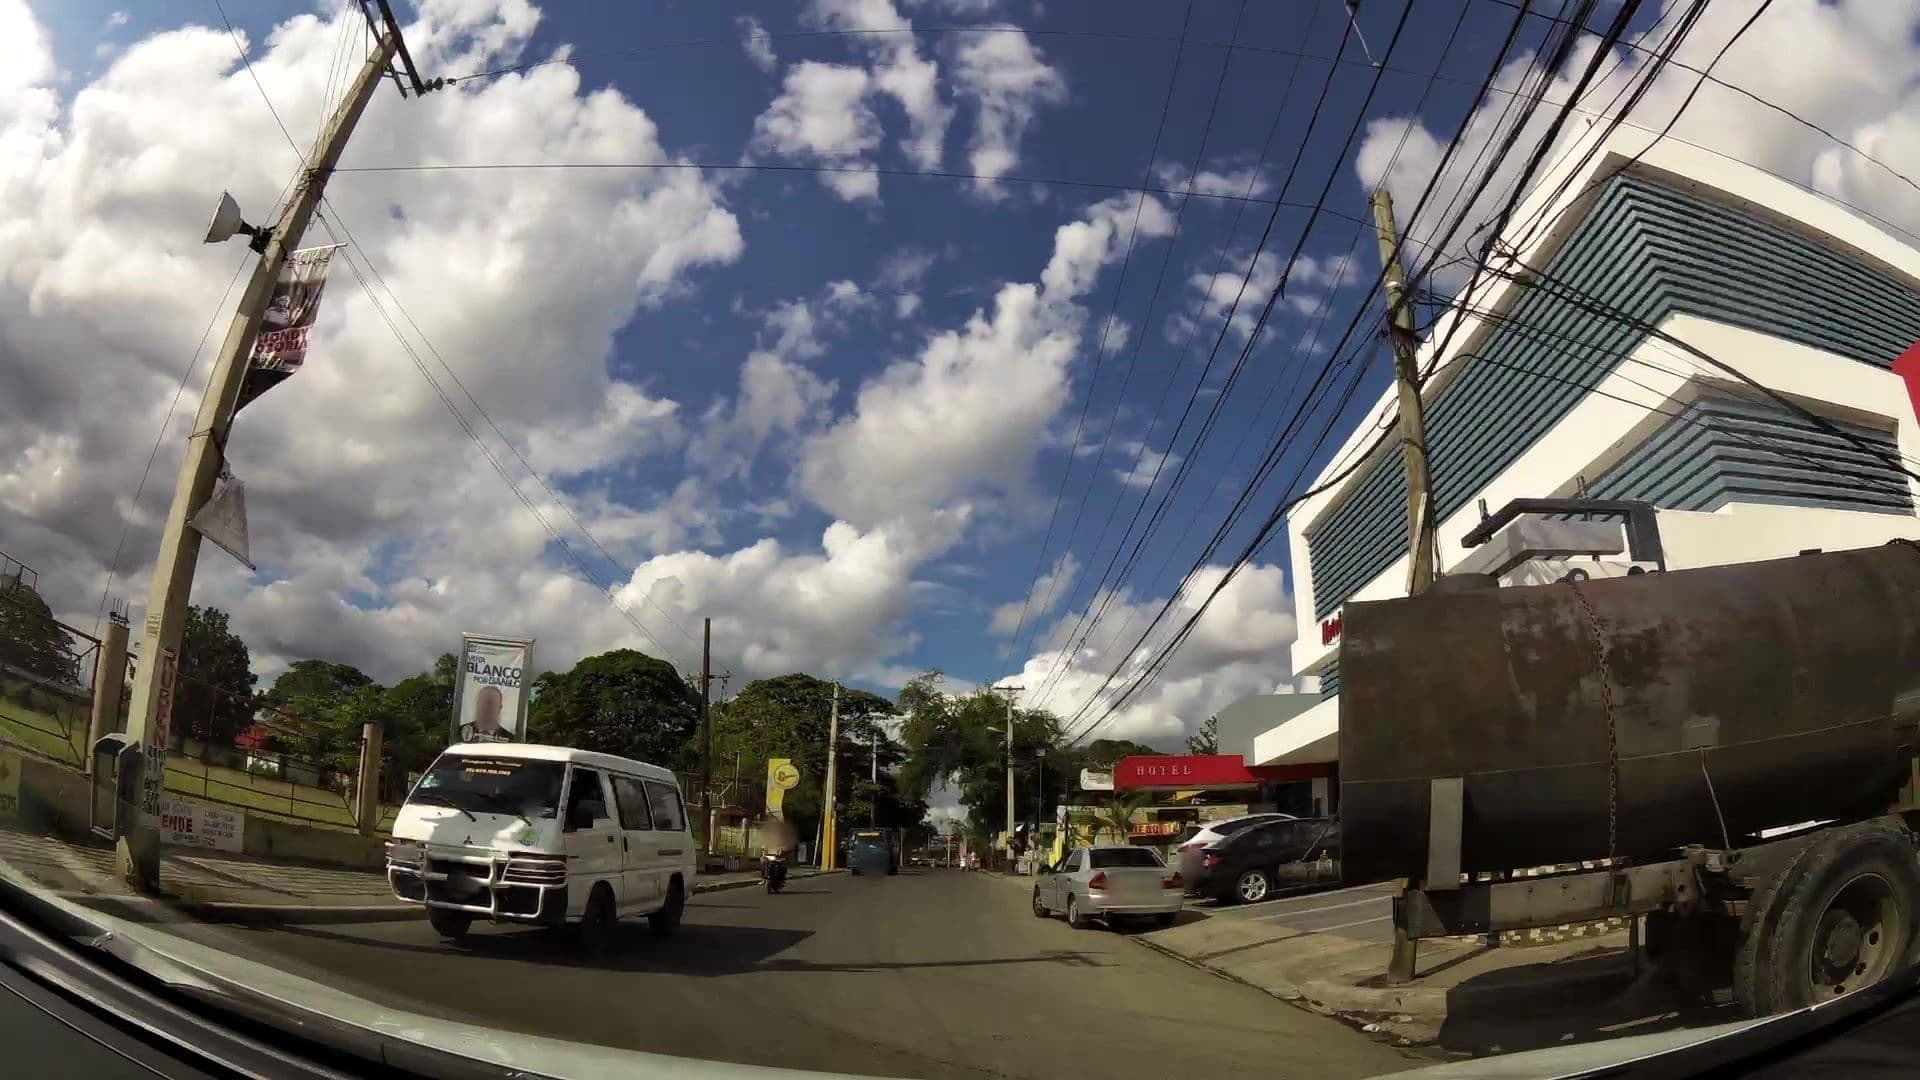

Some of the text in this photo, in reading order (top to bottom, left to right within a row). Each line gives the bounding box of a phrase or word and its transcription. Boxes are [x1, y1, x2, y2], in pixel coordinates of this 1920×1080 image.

[466, 662, 522, 680] BLANCO
[488, 676, 521, 688] DANILO
[1137, 766, 1192, 776] HOTEL
[161, 815, 193, 833] ENDE
